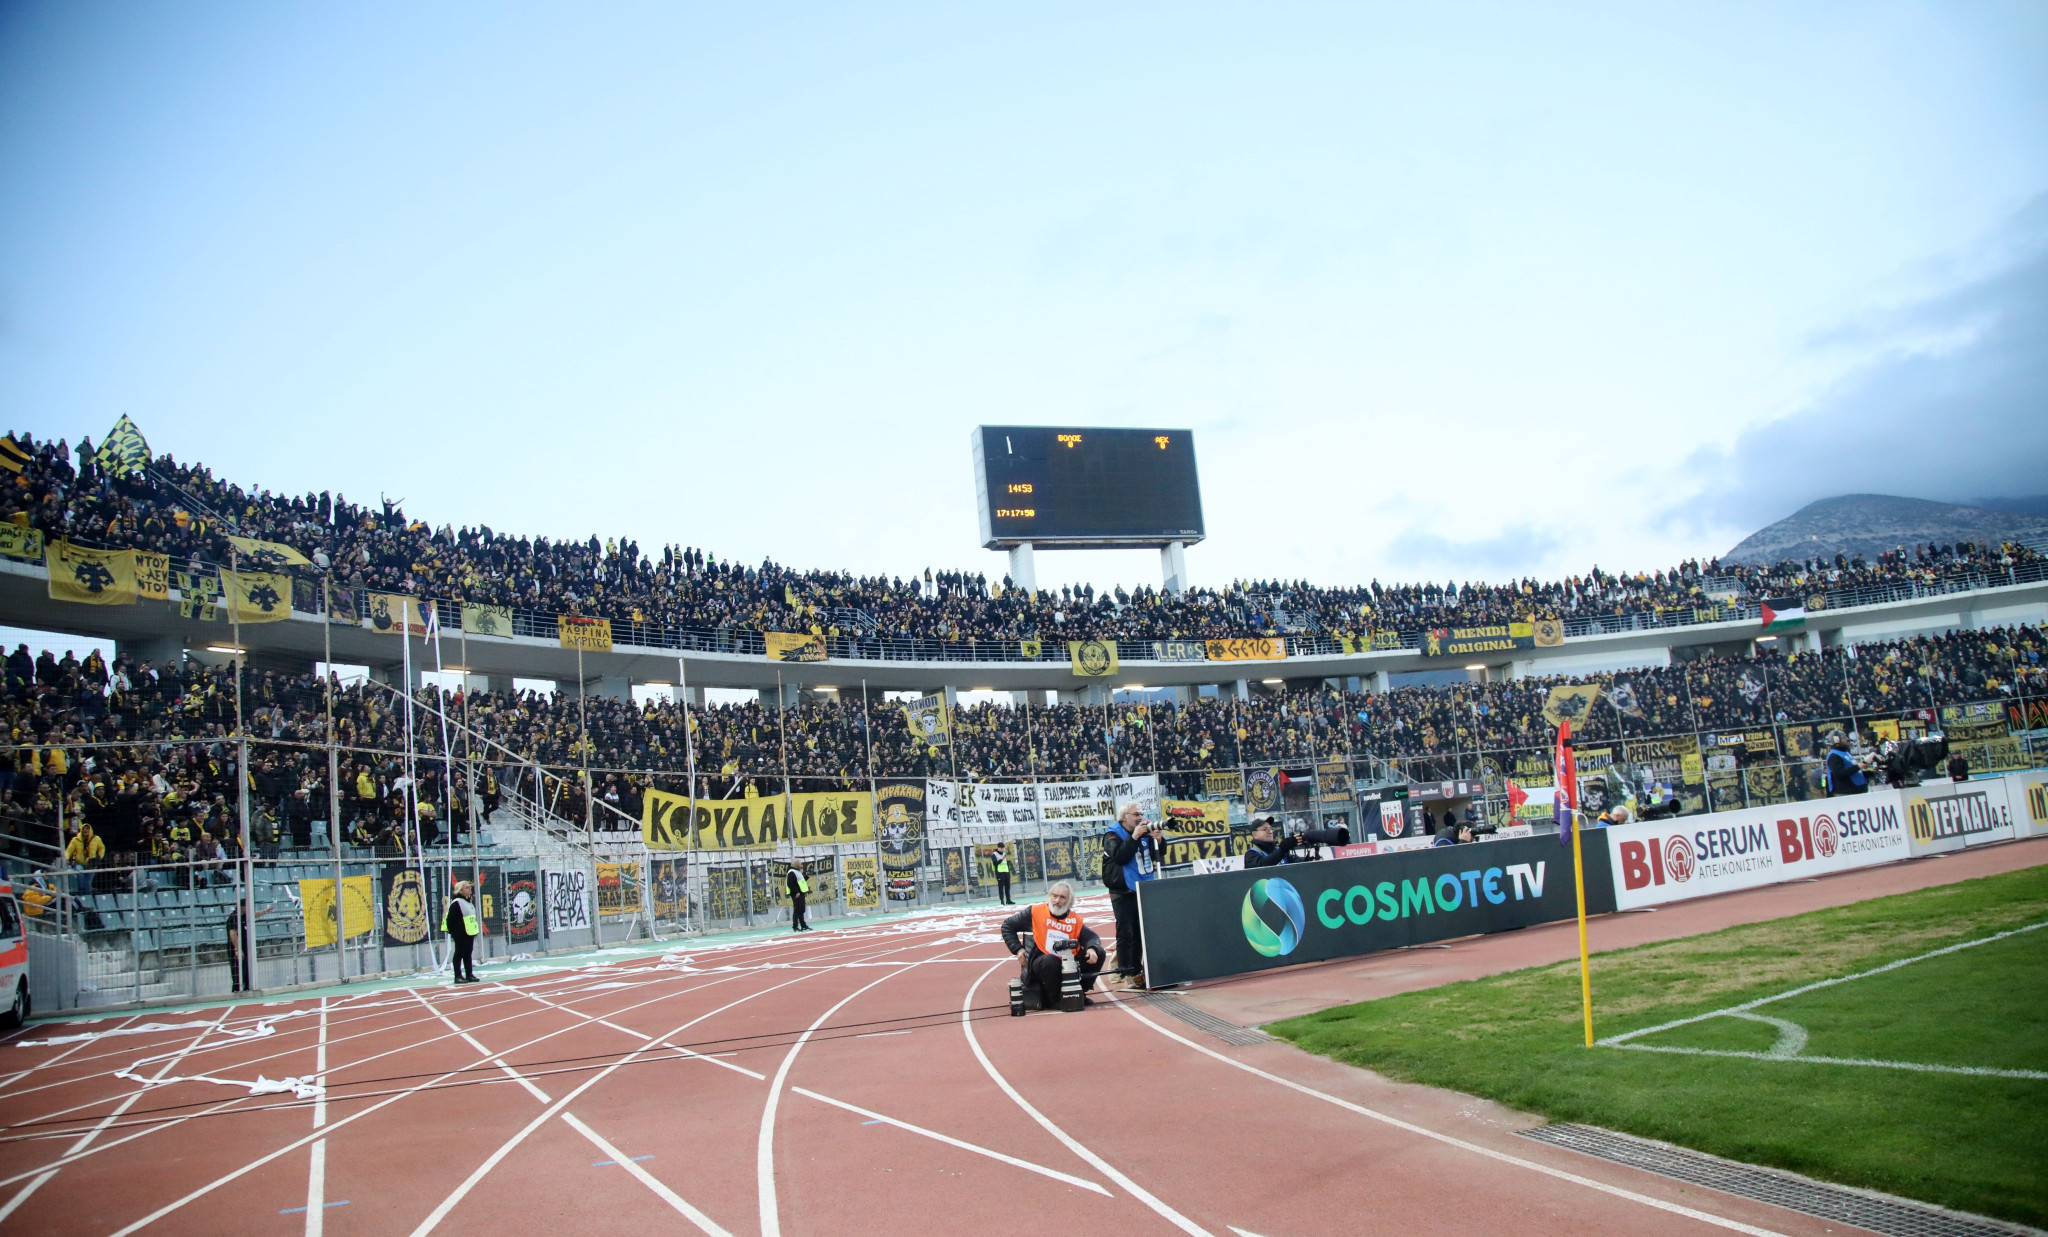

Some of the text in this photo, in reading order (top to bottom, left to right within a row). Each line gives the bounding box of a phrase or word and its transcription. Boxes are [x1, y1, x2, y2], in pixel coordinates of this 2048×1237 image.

[1008, 484, 1033, 493] 14:53
[1453, 626, 1507, 639] MENIDI
[1448, 639, 1517, 654] ORIGINAL
[1207, 776, 1239, 792] RODOS
[650, 797, 859, 848] ΚΟΡΥΔΑΛΛΟΣ
[1174, 820, 1225, 835] ROPOS
[1837, 804, 1899, 838] SERUM
[1513, 830, 1529, 838] STAND
[1695, 823, 1769, 861] SERUM
[1841, 834, 1904, 856] ΑΠΕΙΚΟΝΙΣΤΙΚΗ
[1699, 855, 1774, 880] ΑΠΕΙΚΟΝΙΣΤΙΚΗ
[550, 871, 585, 894] ΠΑΝΟ
[1317, 861, 1546, 929] COSMOTE TV
[655, 896, 688, 916] SKOPEOS
[1046, 918, 1072, 932] PHOTO
